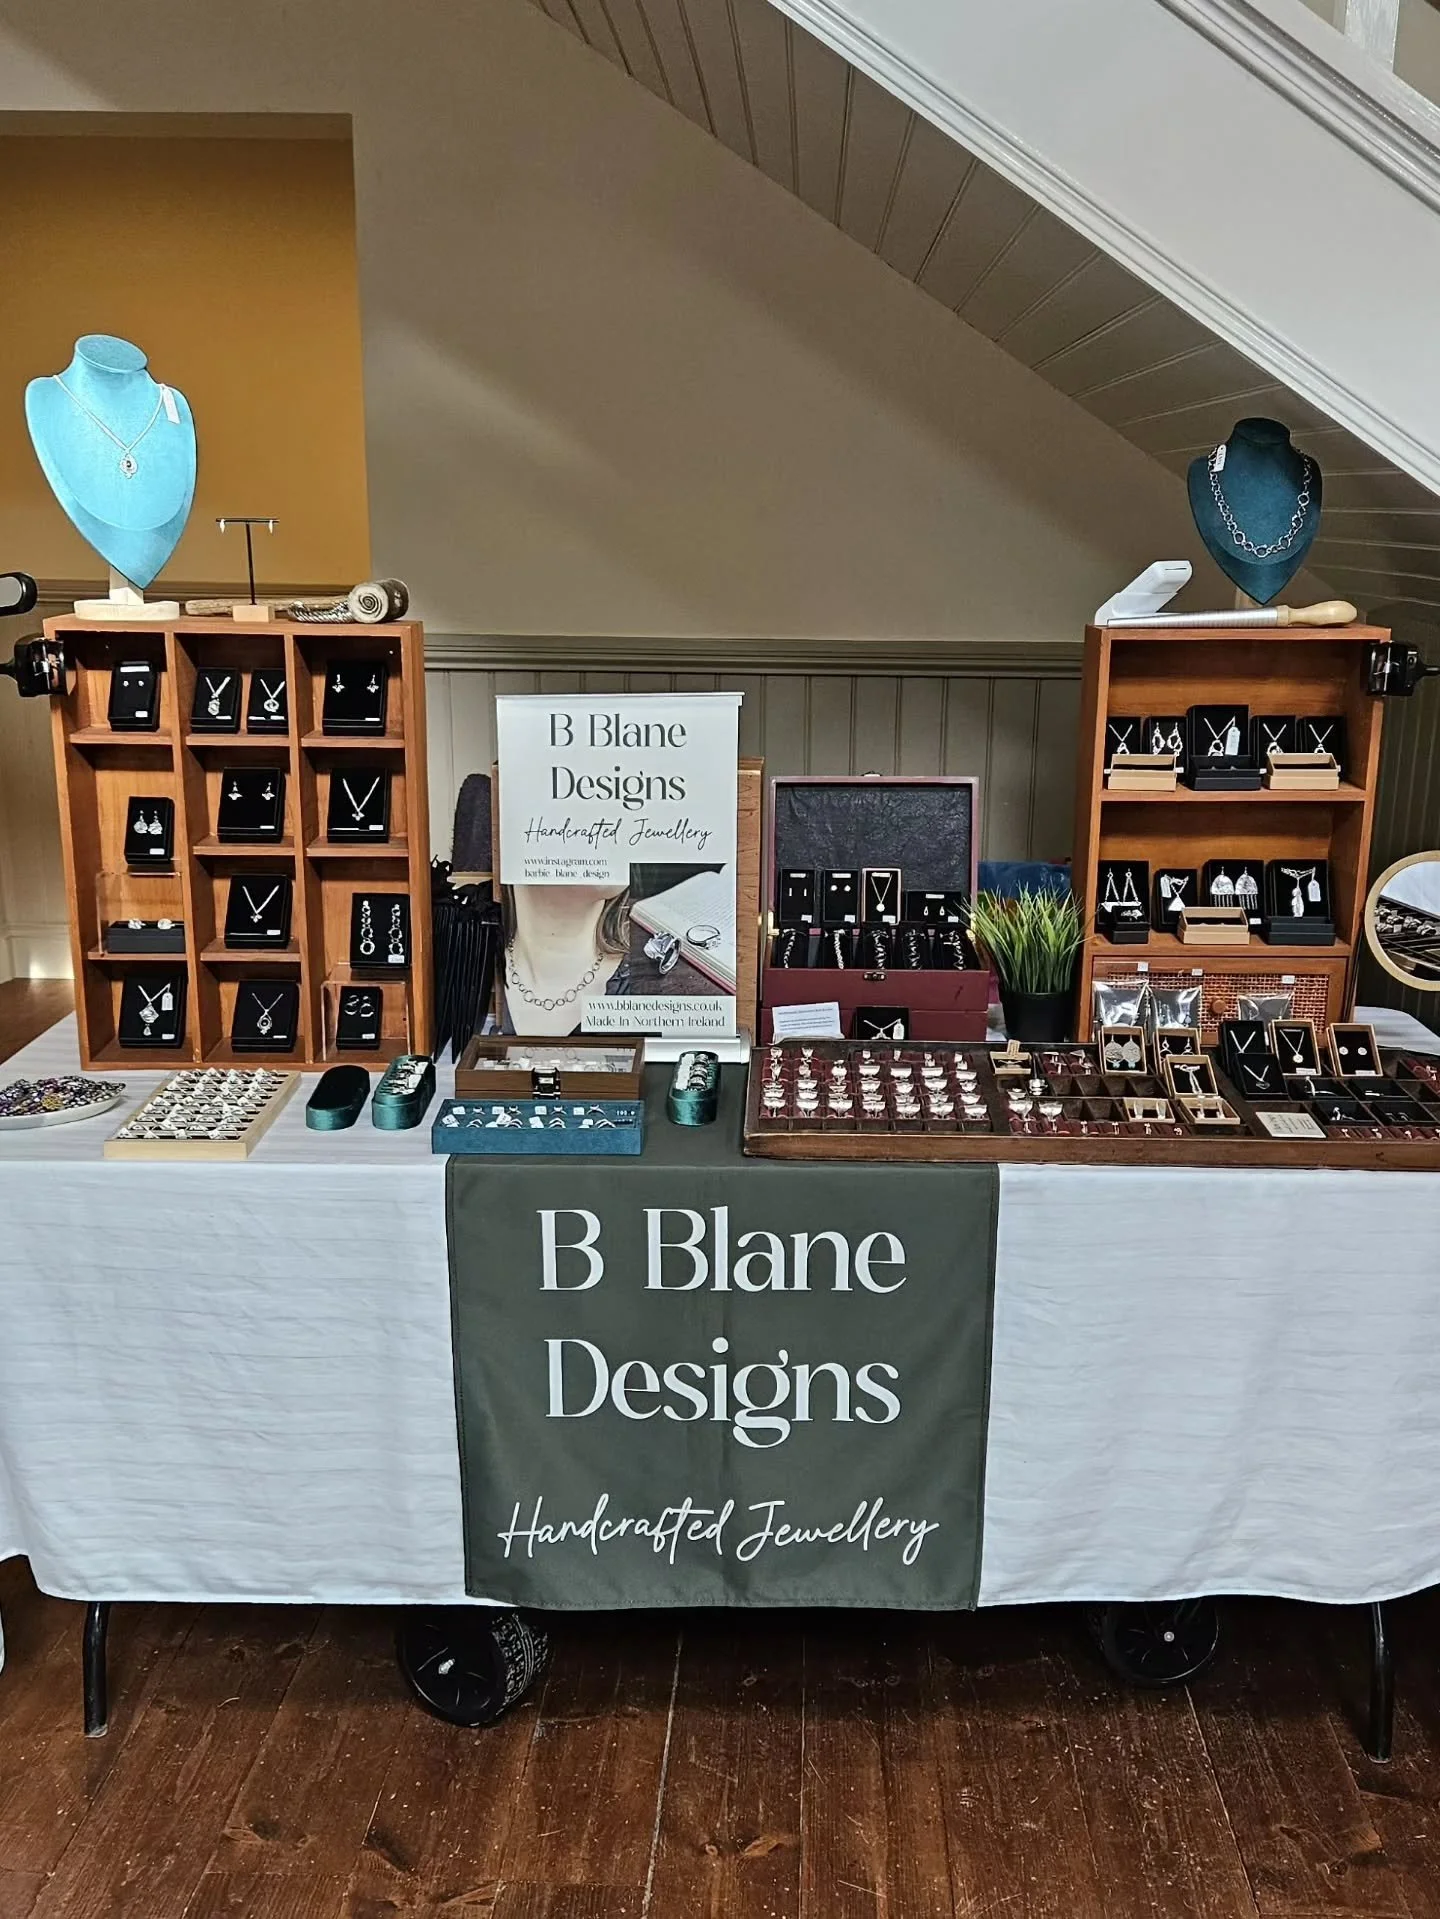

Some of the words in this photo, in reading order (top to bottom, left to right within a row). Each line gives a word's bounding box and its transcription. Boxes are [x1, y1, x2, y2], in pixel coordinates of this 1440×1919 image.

[550, 713, 574, 747] B
[588, 713, 687, 748] Blane
[551, 765, 686, 811] Designs
[524, 816, 623, 850] Handcrafted
[629, 817, 713, 851] Jewellery
[586, 1015, 616, 1027] Made
[620, 1015, 630, 1027] In
[634, 1015, 685, 1027] Northern
[688, 1016, 726, 1027] Ireland
[588, 1000, 722, 1013] www.bblanedesigns.co.uk
[536, 1208, 605, 1291] B
[642, 1205, 907, 1294] Blane
[543, 1336, 901, 1448] Designs
[497, 1493, 735, 1564] Handcrafted
[736, 1497, 940, 1566] Jewellery
